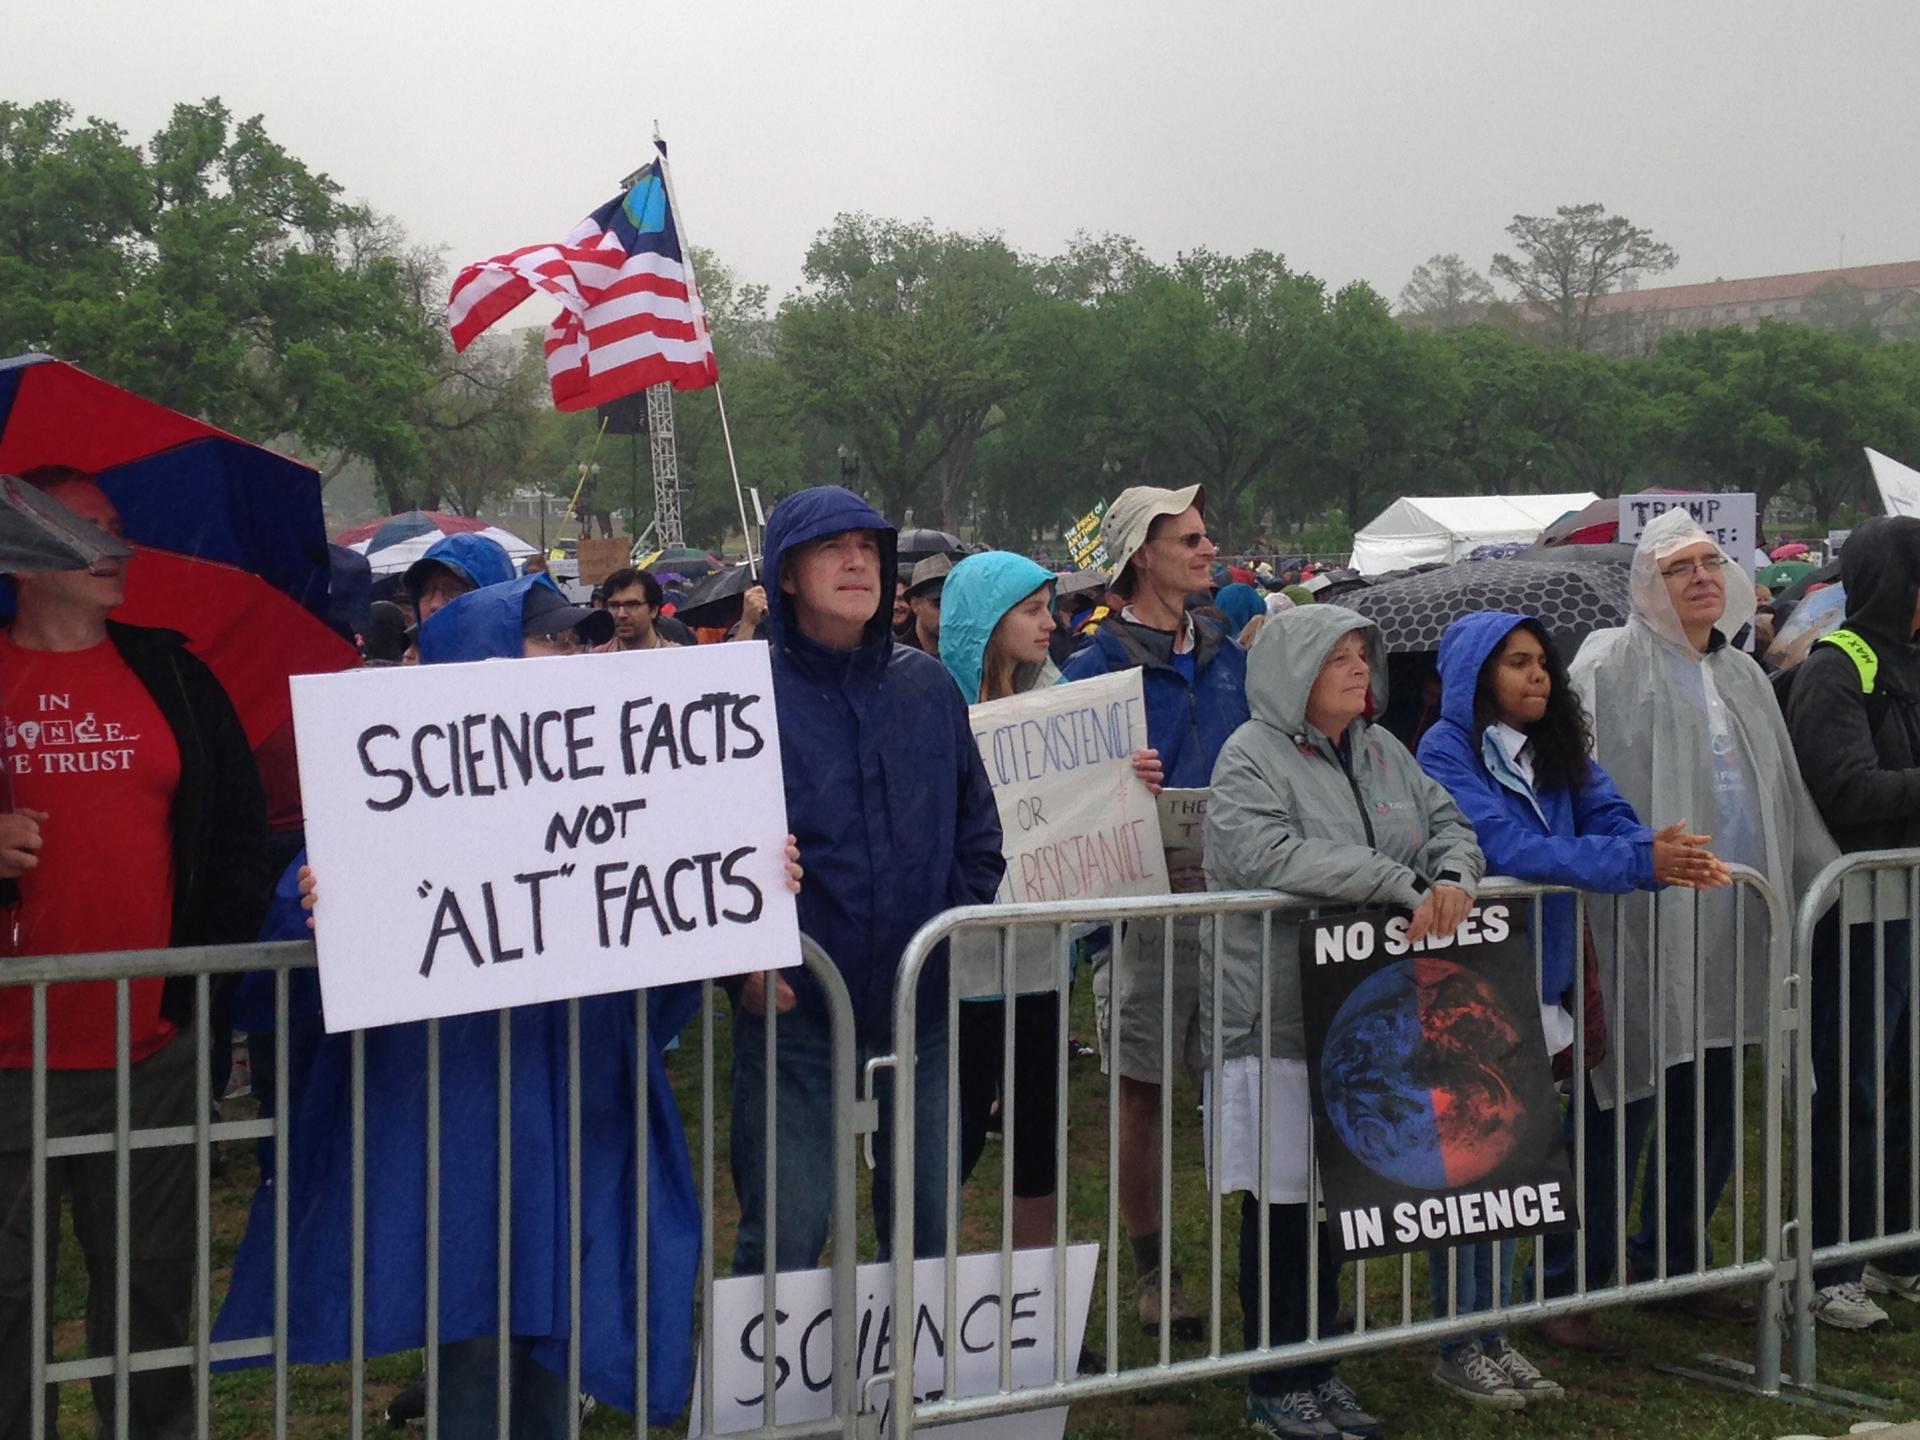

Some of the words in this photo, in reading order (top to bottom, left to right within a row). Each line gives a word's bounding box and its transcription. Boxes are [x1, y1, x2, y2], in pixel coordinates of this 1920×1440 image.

[38, 693, 70, 711] IN
[38, 749, 134, 774] TRUST
[357, 706, 604, 812] SCIENCE
[620, 692, 765, 776] FACTS
[545, 799, 646, 853] NOT
[1017, 796, 1048, 831] OR
[1020, 819, 1153, 902] RESISTANCE
[594, 846, 764, 948] FACTS
[1315, 921, 1375, 965] NO
[1384, 905, 1510, 956] SES
[1340, 1206, 1385, 1251] IN
[1393, 1181, 1566, 1243] SCIENCE
